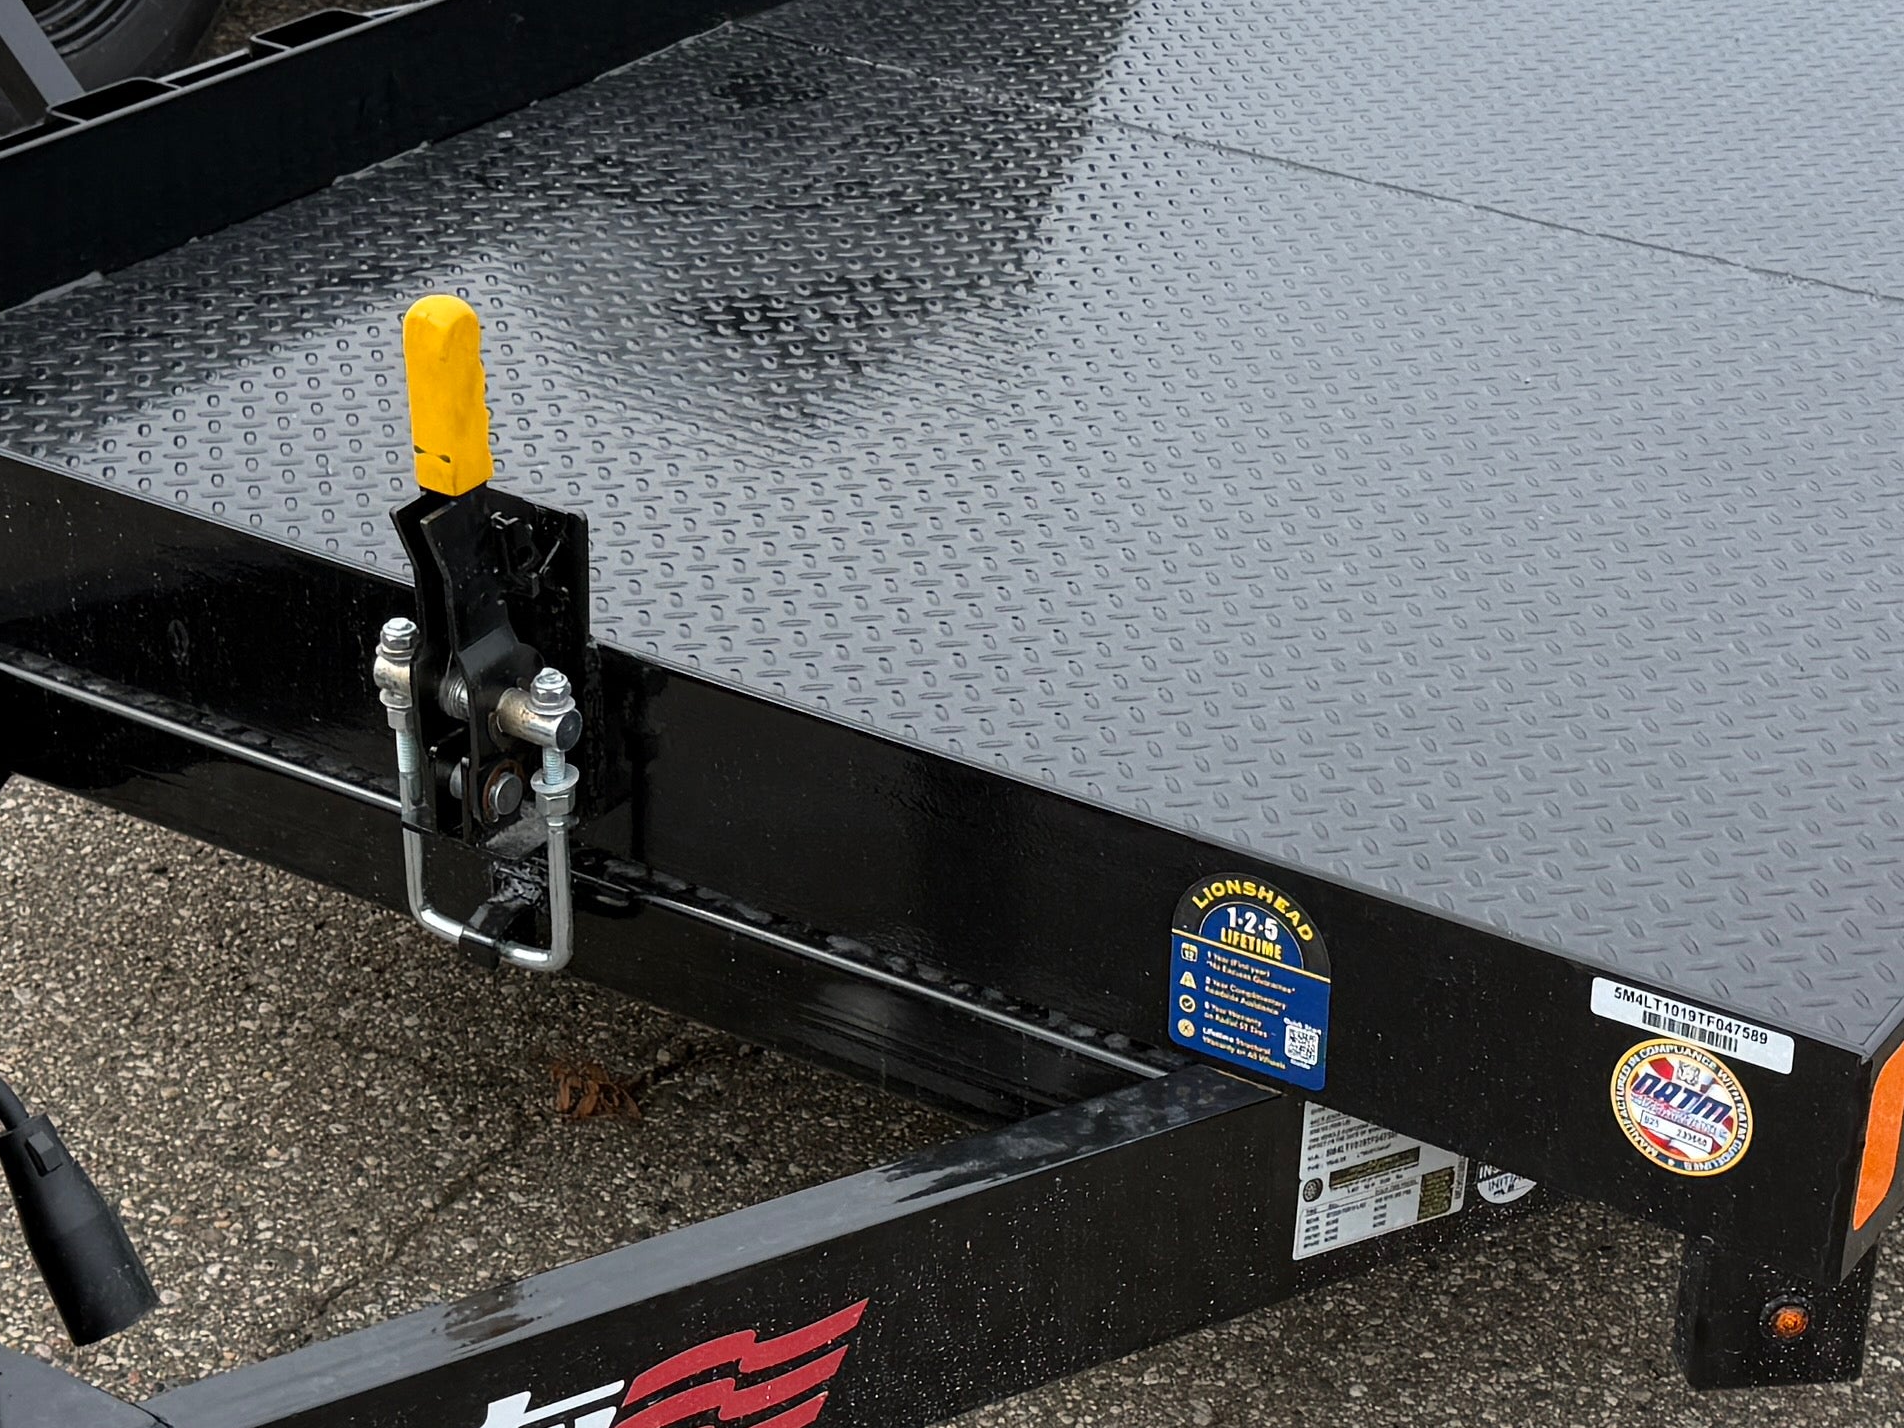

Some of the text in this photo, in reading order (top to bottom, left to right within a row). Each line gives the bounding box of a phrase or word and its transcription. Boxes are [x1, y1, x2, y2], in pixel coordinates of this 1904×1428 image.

[1192, 879, 1314, 941] LIONSHEAD
[1220, 927, 1283, 961] LIFETIME
[1614, 987, 1768, 1044] 5M4LT1019TF047589
